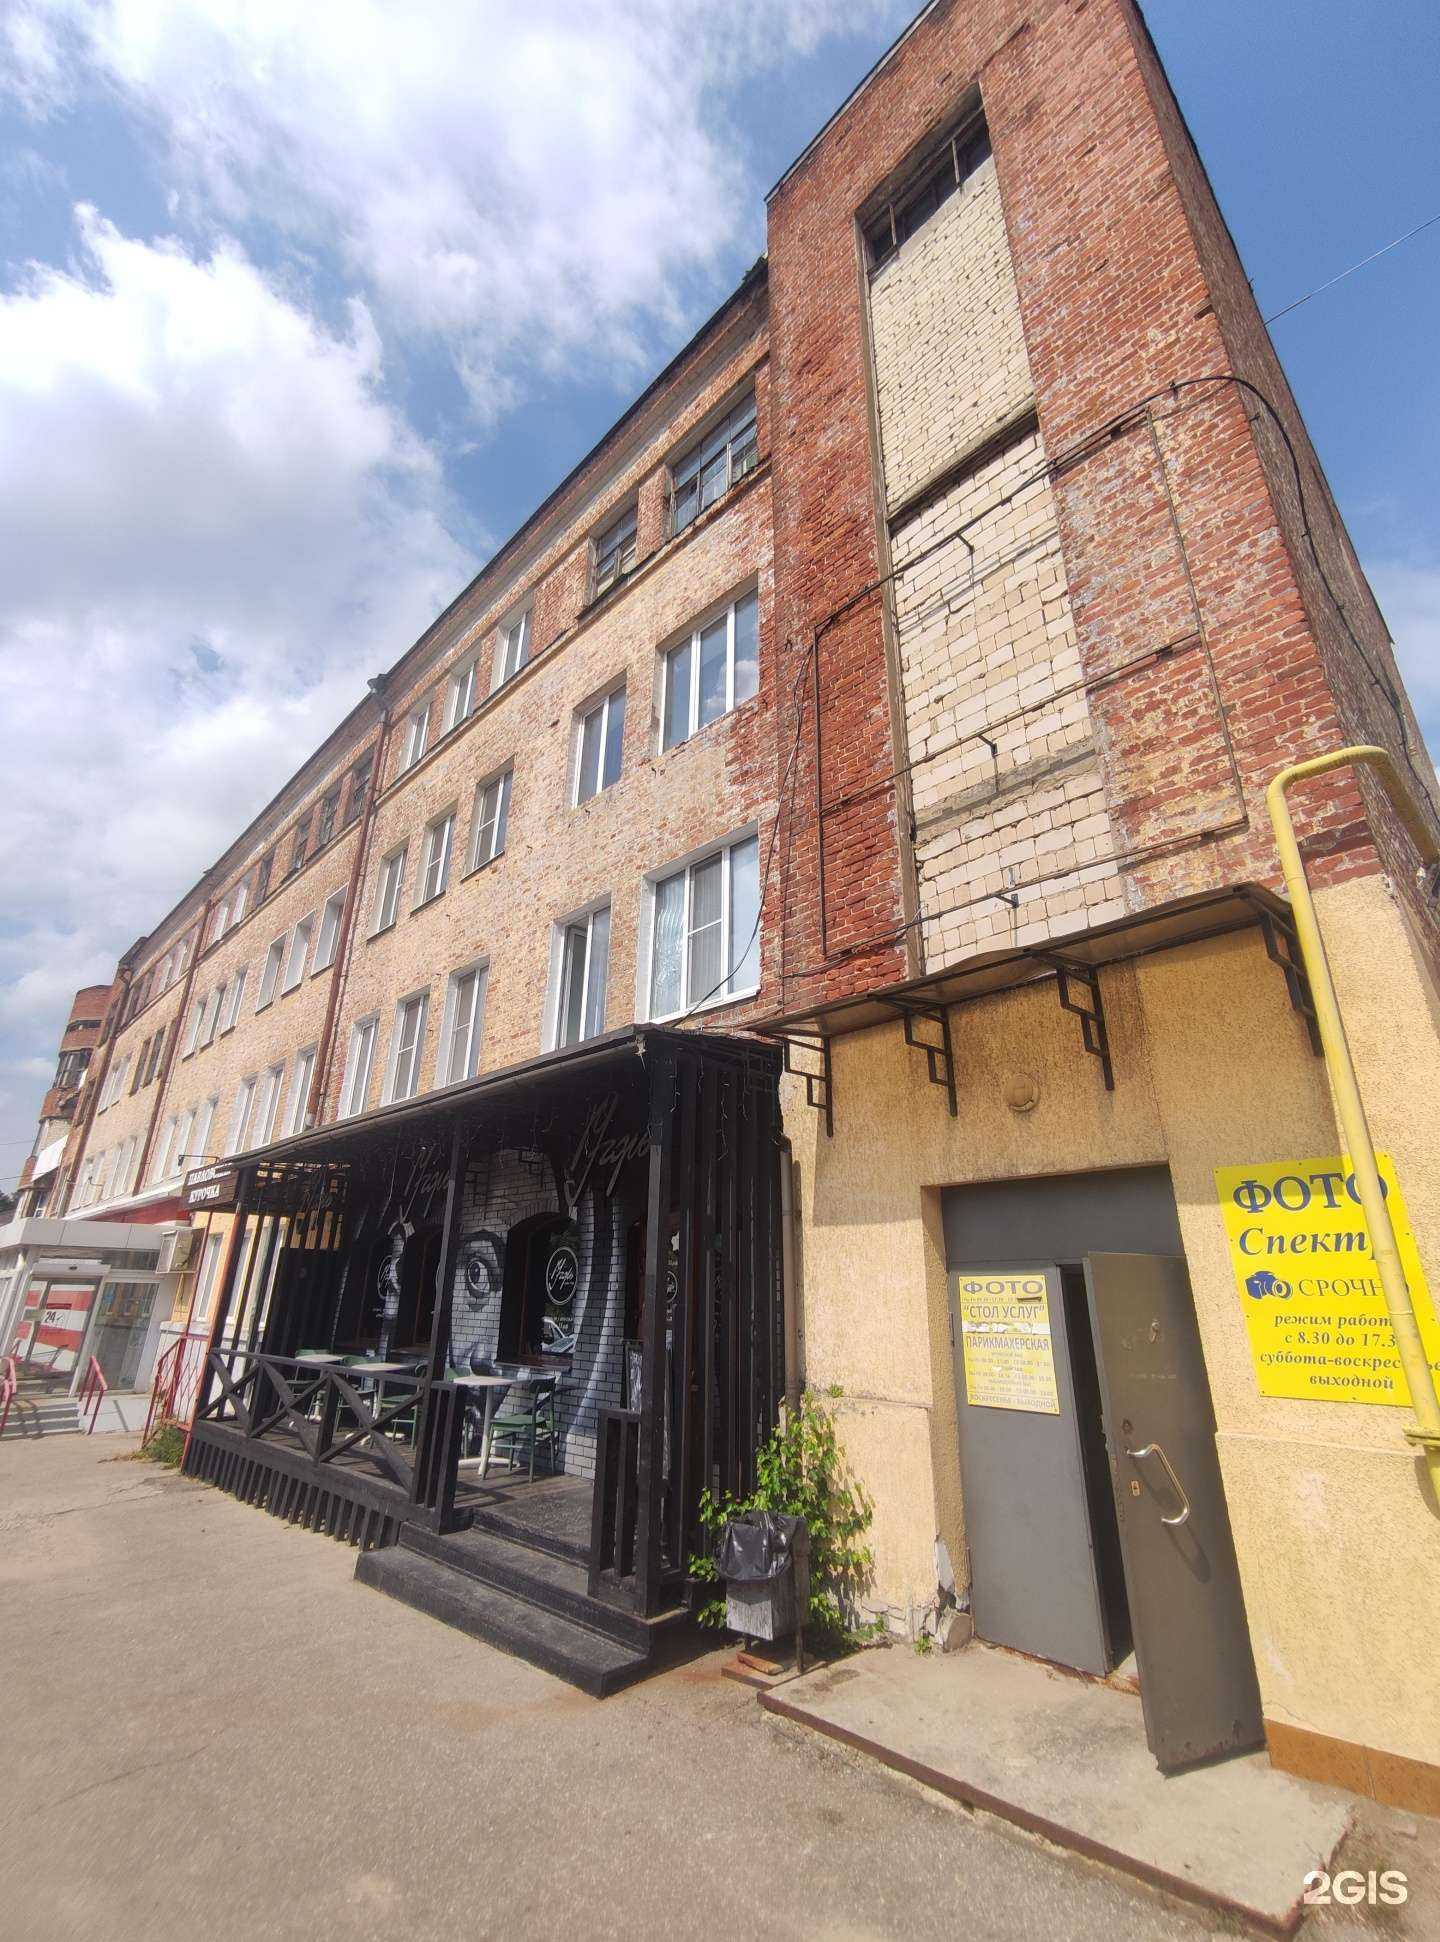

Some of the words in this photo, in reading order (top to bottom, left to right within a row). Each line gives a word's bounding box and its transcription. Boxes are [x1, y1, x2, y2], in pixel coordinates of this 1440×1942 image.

[188, 1184, 220, 1203] КУРОЧКА
[1233, 1173, 1388, 1213] ФОТО
[1239, 1227, 1377, 1260] Спект
[963, 1281, 1043, 1294] ФОТО
[1298, 1278, 1409, 1298] СРОЧН
[1274, 1314, 1332, 1328] режим
[1338, 1313, 1393, 1328] работ
[966, 1336, 1049, 1351] ПАРИКМАХЕРСКАЯ
[1285, 1335, 1292, 1344] с
[1298, 1332, 1330, 1345] 8.30
[1336, 1333, 1355, 1347] до
[1363, 1334, 1397, 1347] 17.3
[1309, 1375, 1394, 1390] выходной
